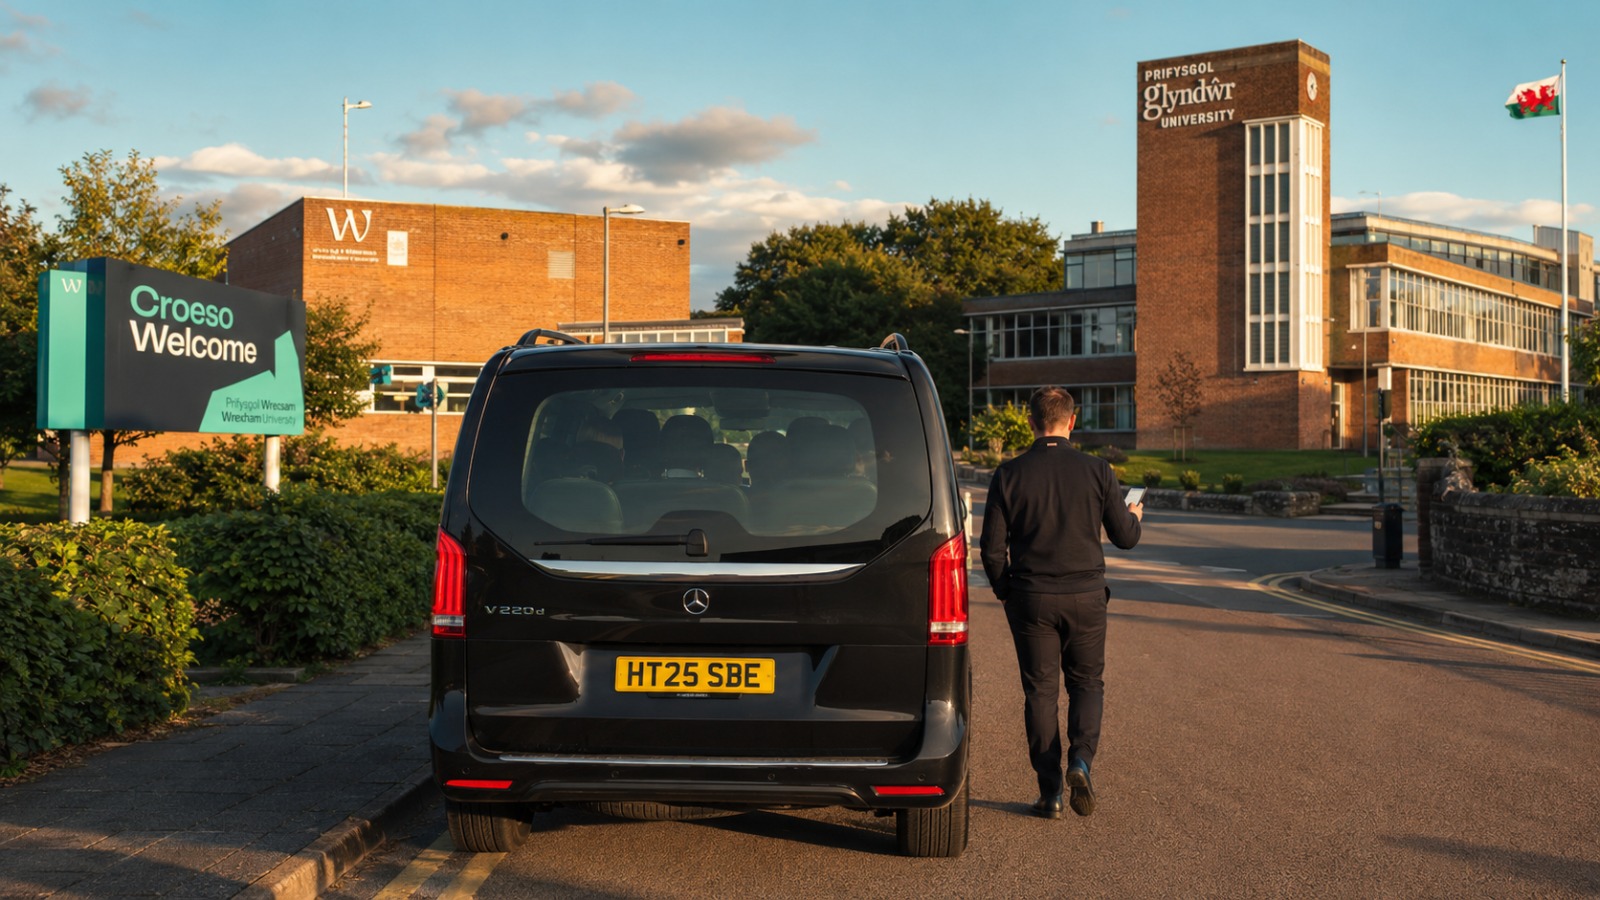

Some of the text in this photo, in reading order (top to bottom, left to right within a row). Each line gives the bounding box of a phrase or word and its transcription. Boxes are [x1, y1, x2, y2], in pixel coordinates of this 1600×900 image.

[1145, 62, 1214, 81] PRIFYSGOL
[1143, 77, 1236, 121] glyndŵr
[1161, 109, 1235, 128] UNIVERSITY
[325, 207, 372, 242] W
[61, 277, 82, 293] W
[130, 285, 234, 329] Croeso
[129, 319, 257, 364] Welcome
[627, 661, 761, 688] HT25 SBE
